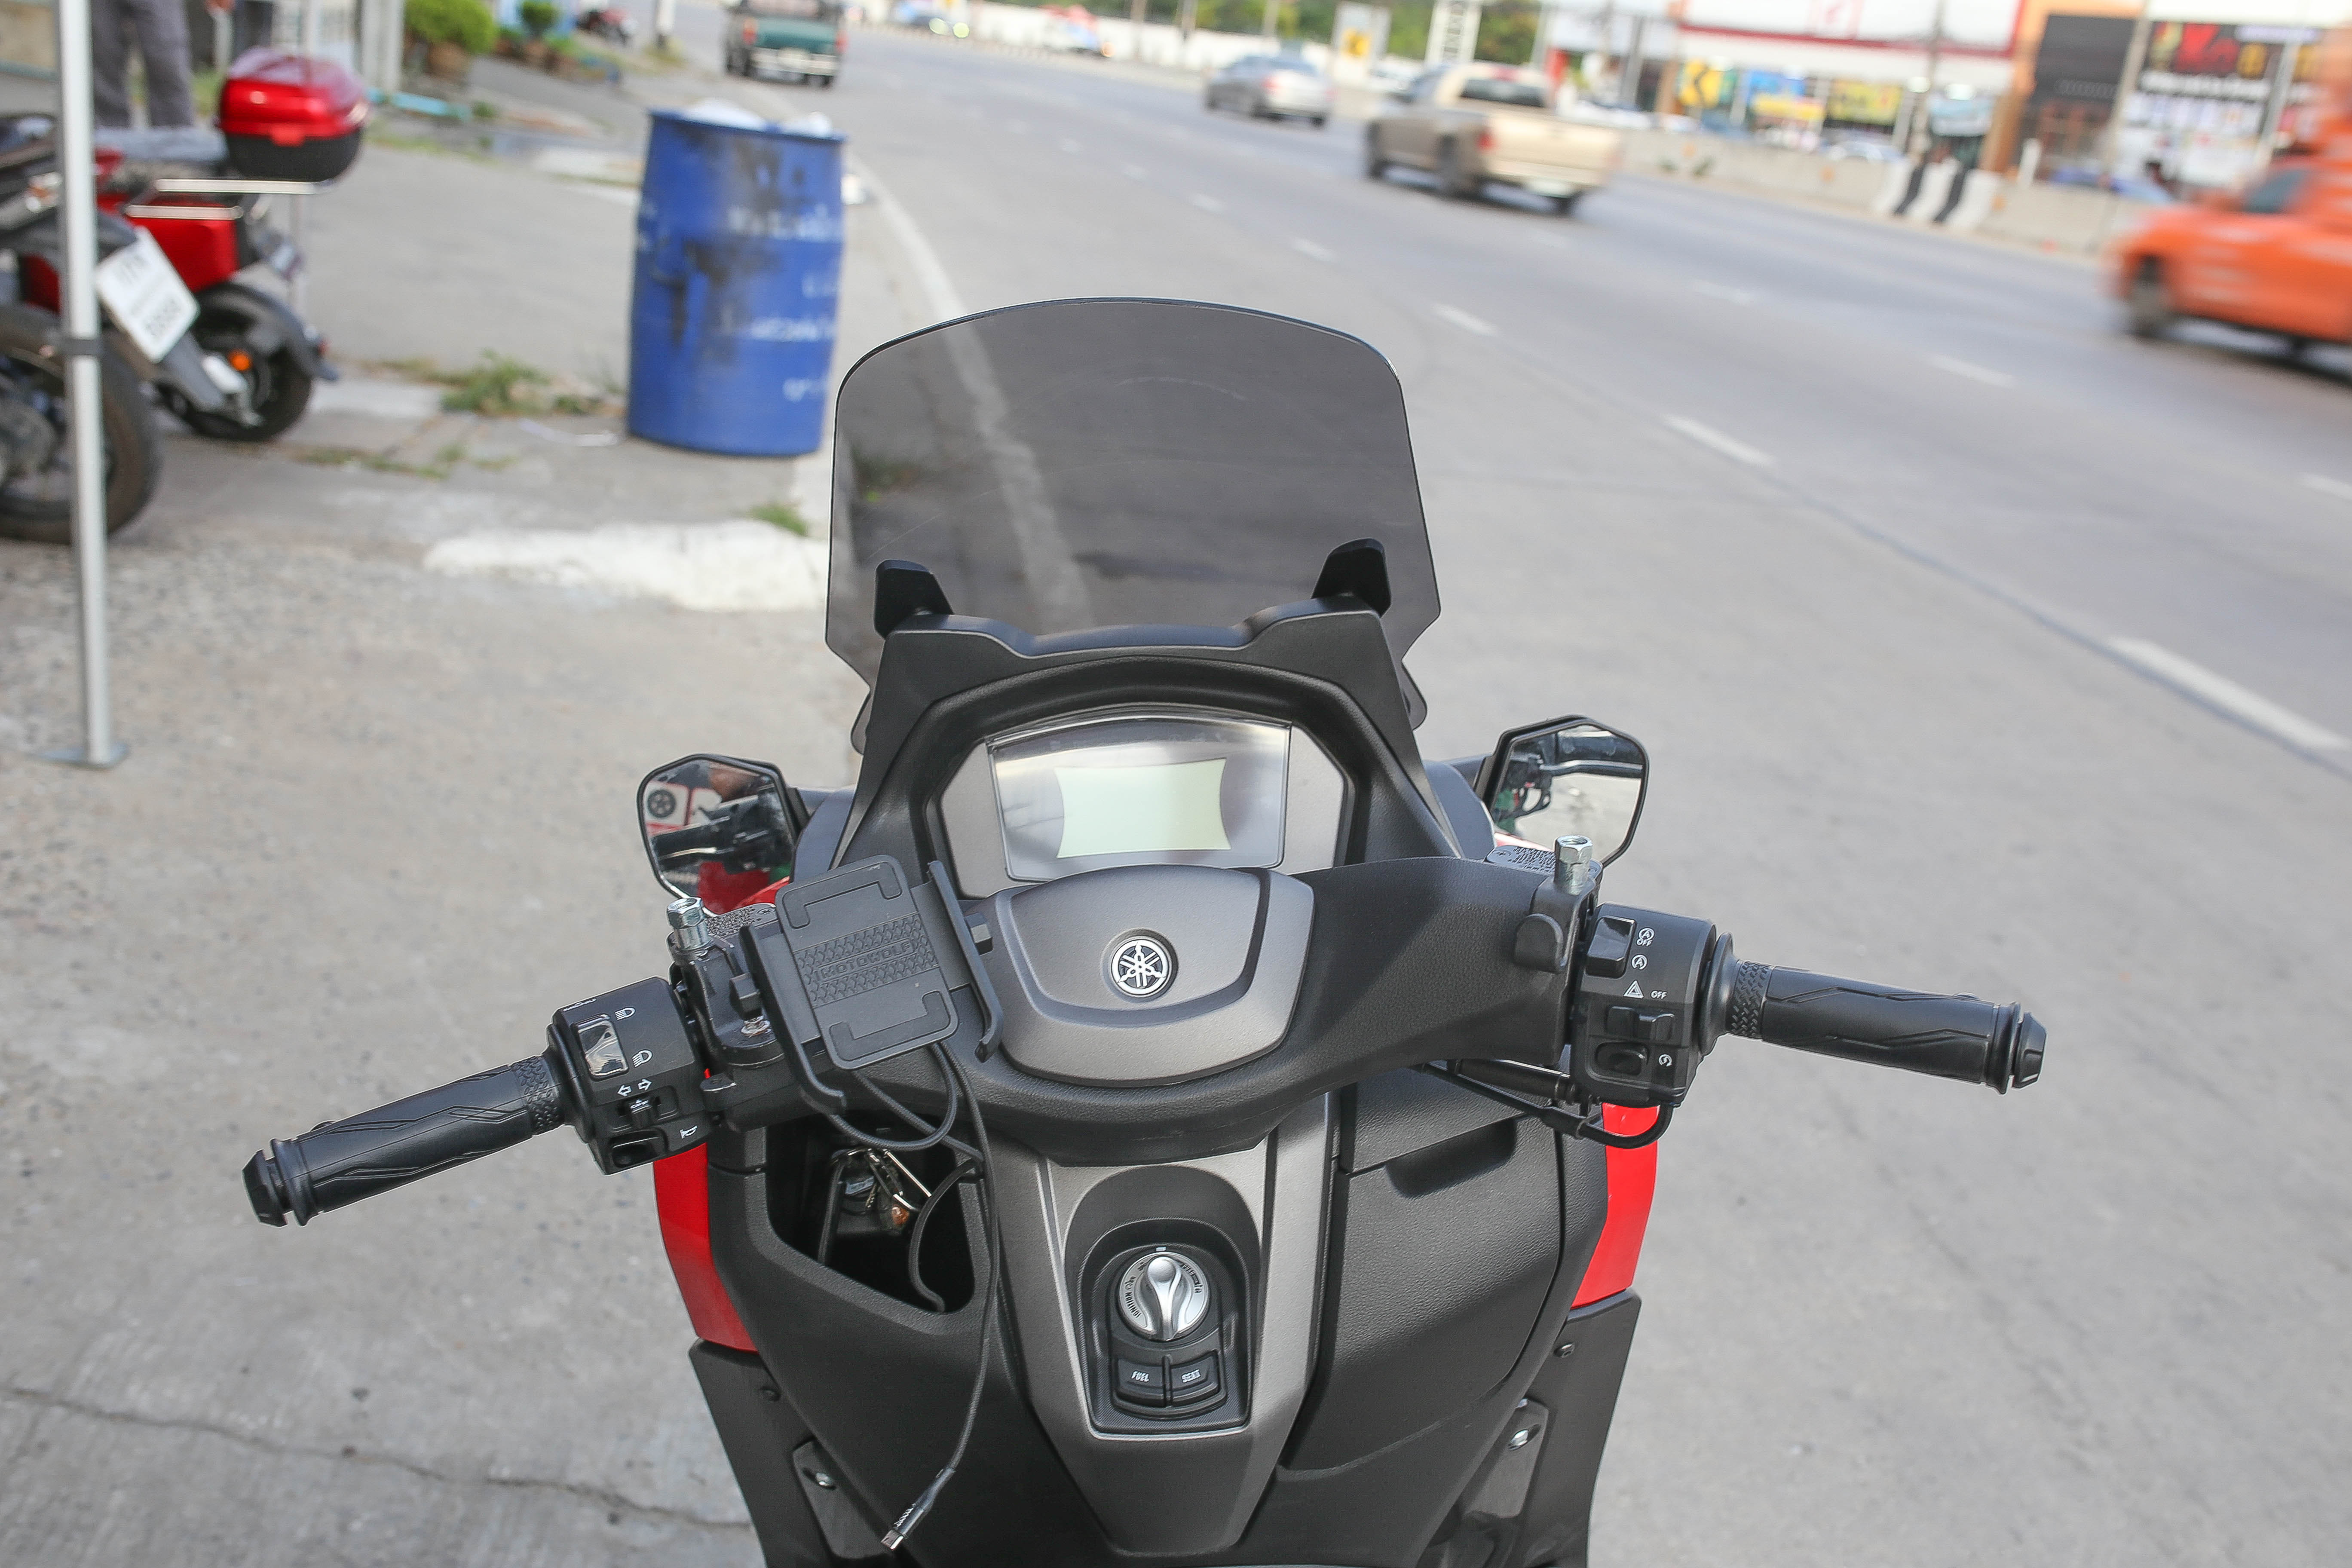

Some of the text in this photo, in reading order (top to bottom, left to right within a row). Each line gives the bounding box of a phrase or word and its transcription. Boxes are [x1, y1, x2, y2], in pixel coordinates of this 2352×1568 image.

[1636, 938, 1653, 946] OFF
[820, 940, 911, 979] MOTOWOLF
[1651, 990, 1667, 999] OFF
[1131, 1371, 1149, 1382] FUEL
